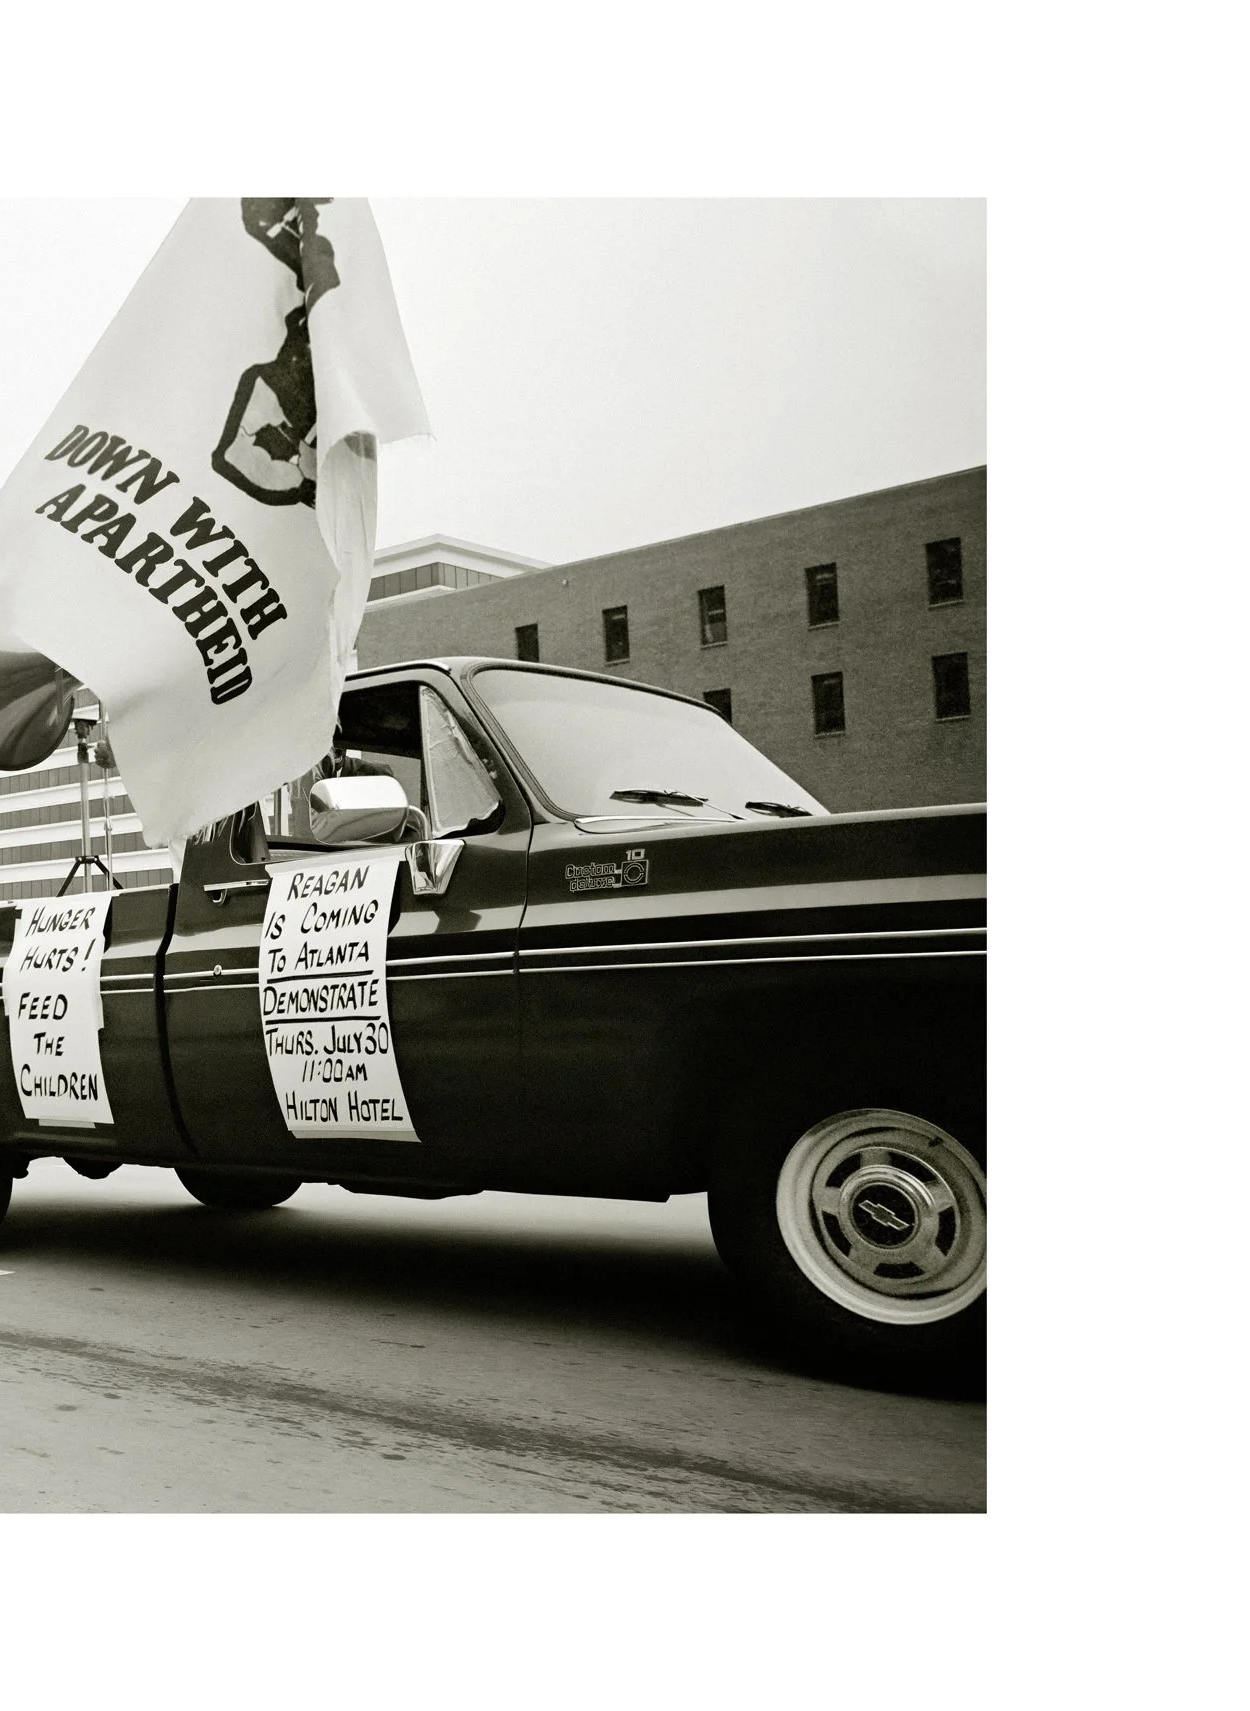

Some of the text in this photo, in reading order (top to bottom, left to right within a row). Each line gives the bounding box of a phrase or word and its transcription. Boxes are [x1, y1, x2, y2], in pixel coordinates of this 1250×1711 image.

[44, 424, 288, 641] DOWN WITH
[35, 483, 253, 705] APARTHEID
[626, 848, 646, 860] 10
[287, 865, 370, 901] REAGAN
[565, 862, 617, 879] Custom
[24, 905, 96, 938] HUNGER
[265, 899, 379, 940] IS COMING
[294, 941, 370, 971] ATLANTA
[18, 992, 69, 1021] FEED
[262, 979, 380, 1016] DEMONSTRATE
[33, 1031, 66, 1057] THE
[265, 1028, 318, 1057] THURS.
[20, 1063, 99, 1101] CHILDREN
[286, 1090, 404, 1122] HILTON HOTEL
